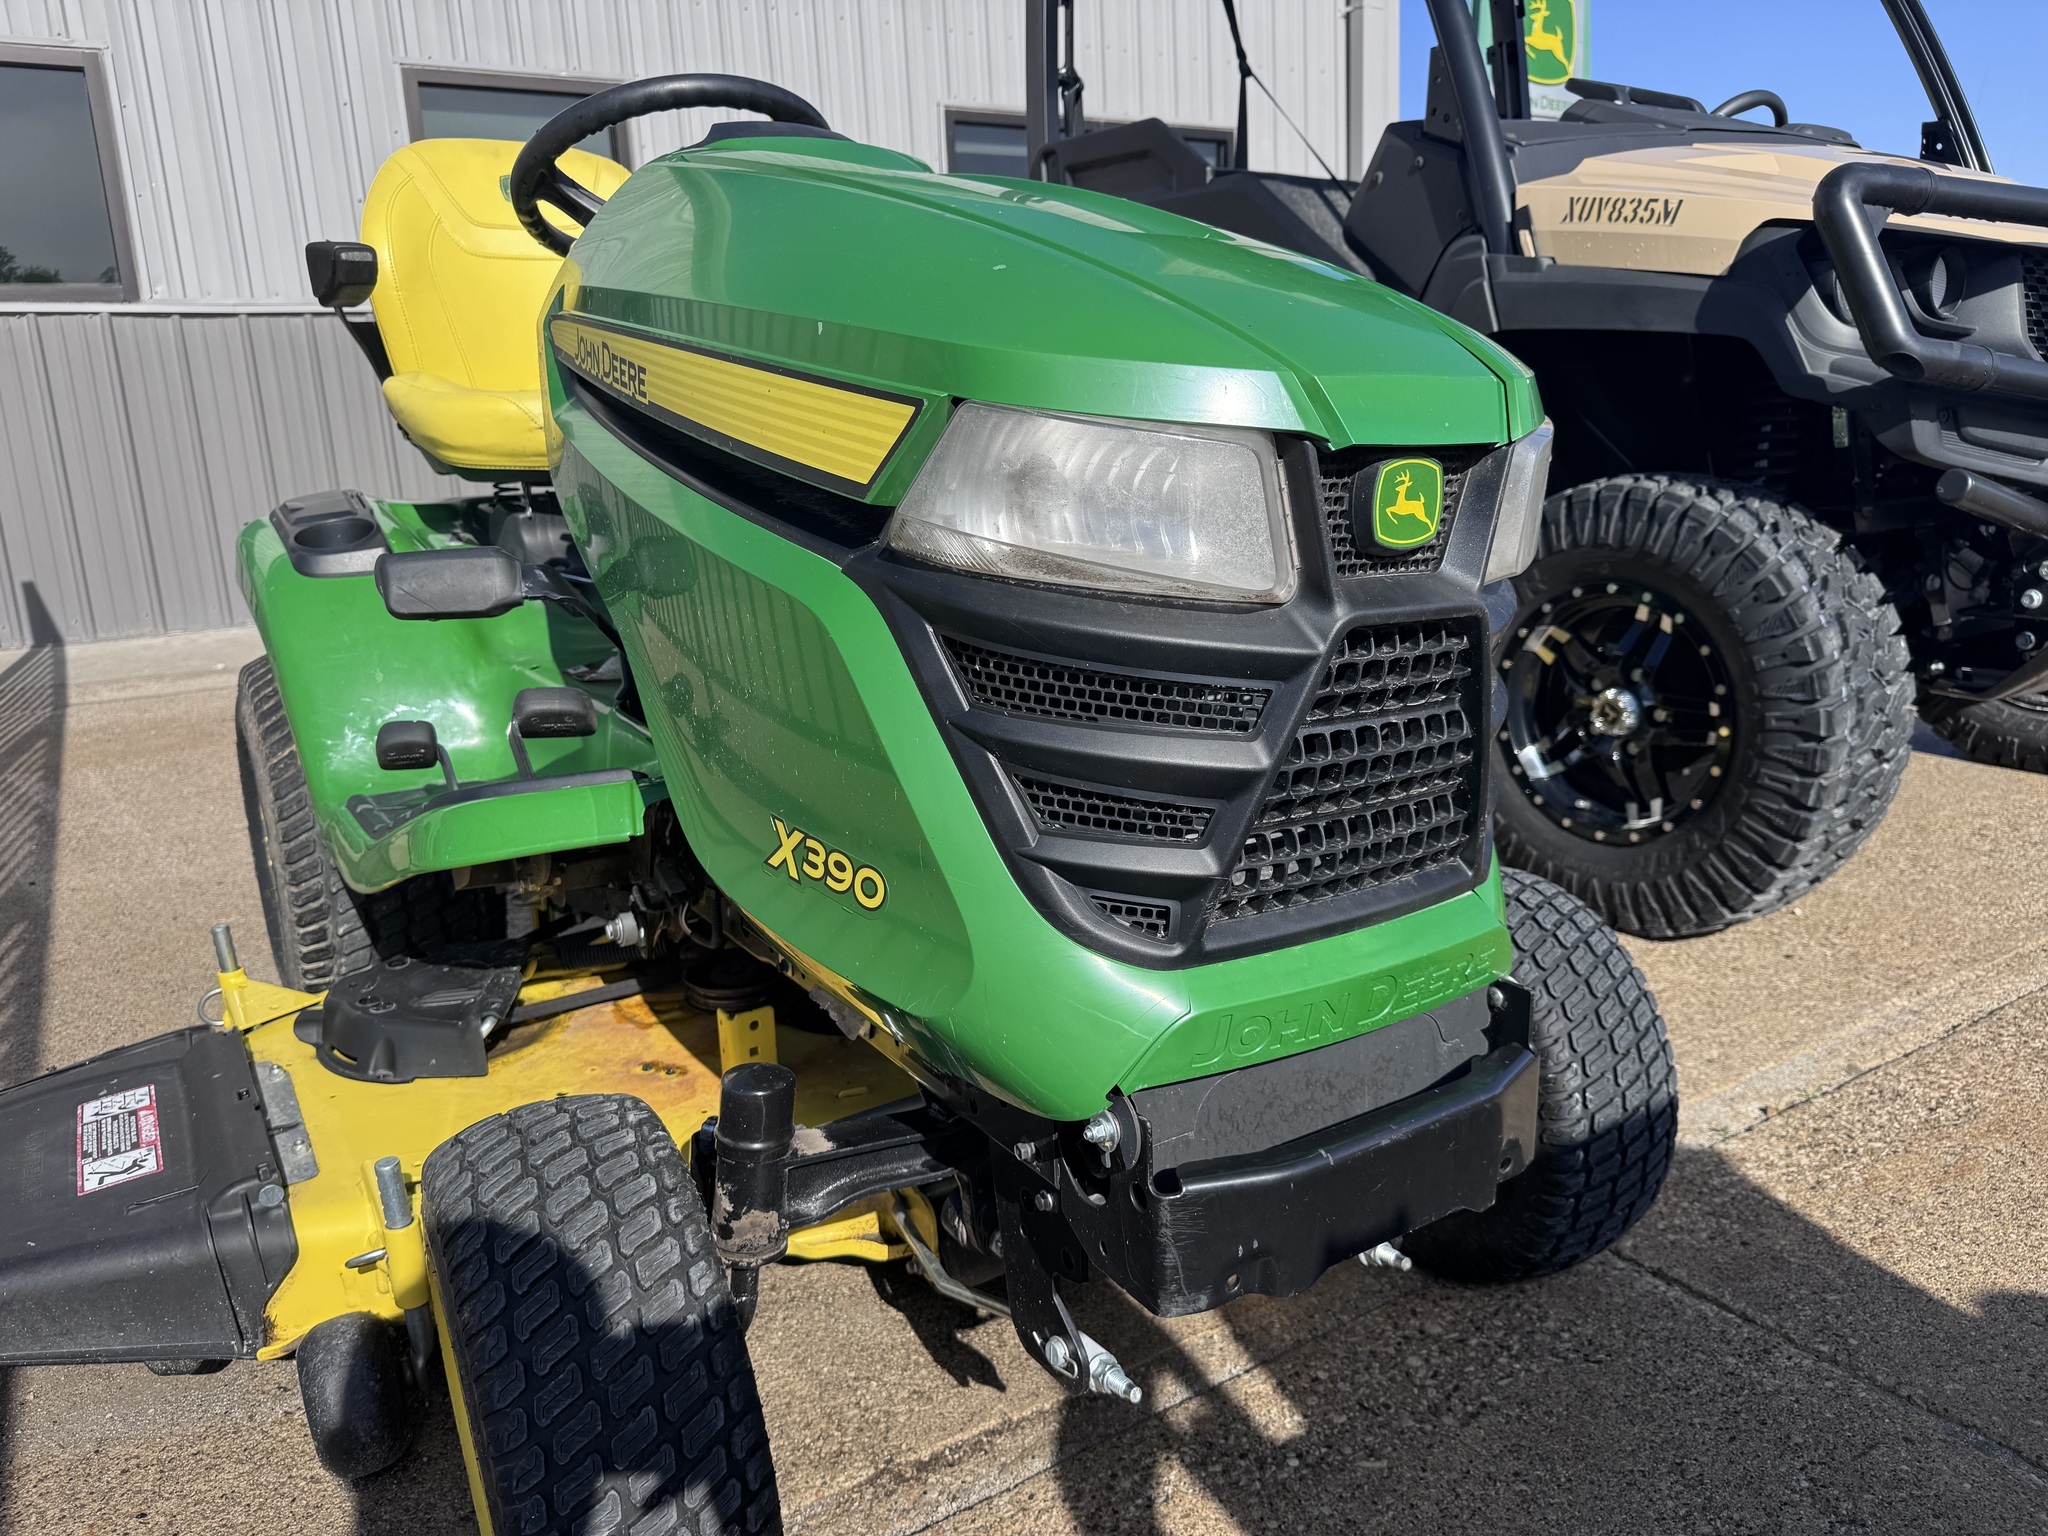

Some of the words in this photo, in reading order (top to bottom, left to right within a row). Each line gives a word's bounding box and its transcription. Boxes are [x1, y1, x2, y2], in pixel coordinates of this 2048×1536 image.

[1560, 196, 1684, 225] XUV835M
[574, 326, 603, 380] JOHN
[601, 340, 648, 402] DEERE
[763, 814, 887, 912] X390
[1191, 993, 1351, 1068] JOHN
[1357, 941, 1495, 1026] DEERE
